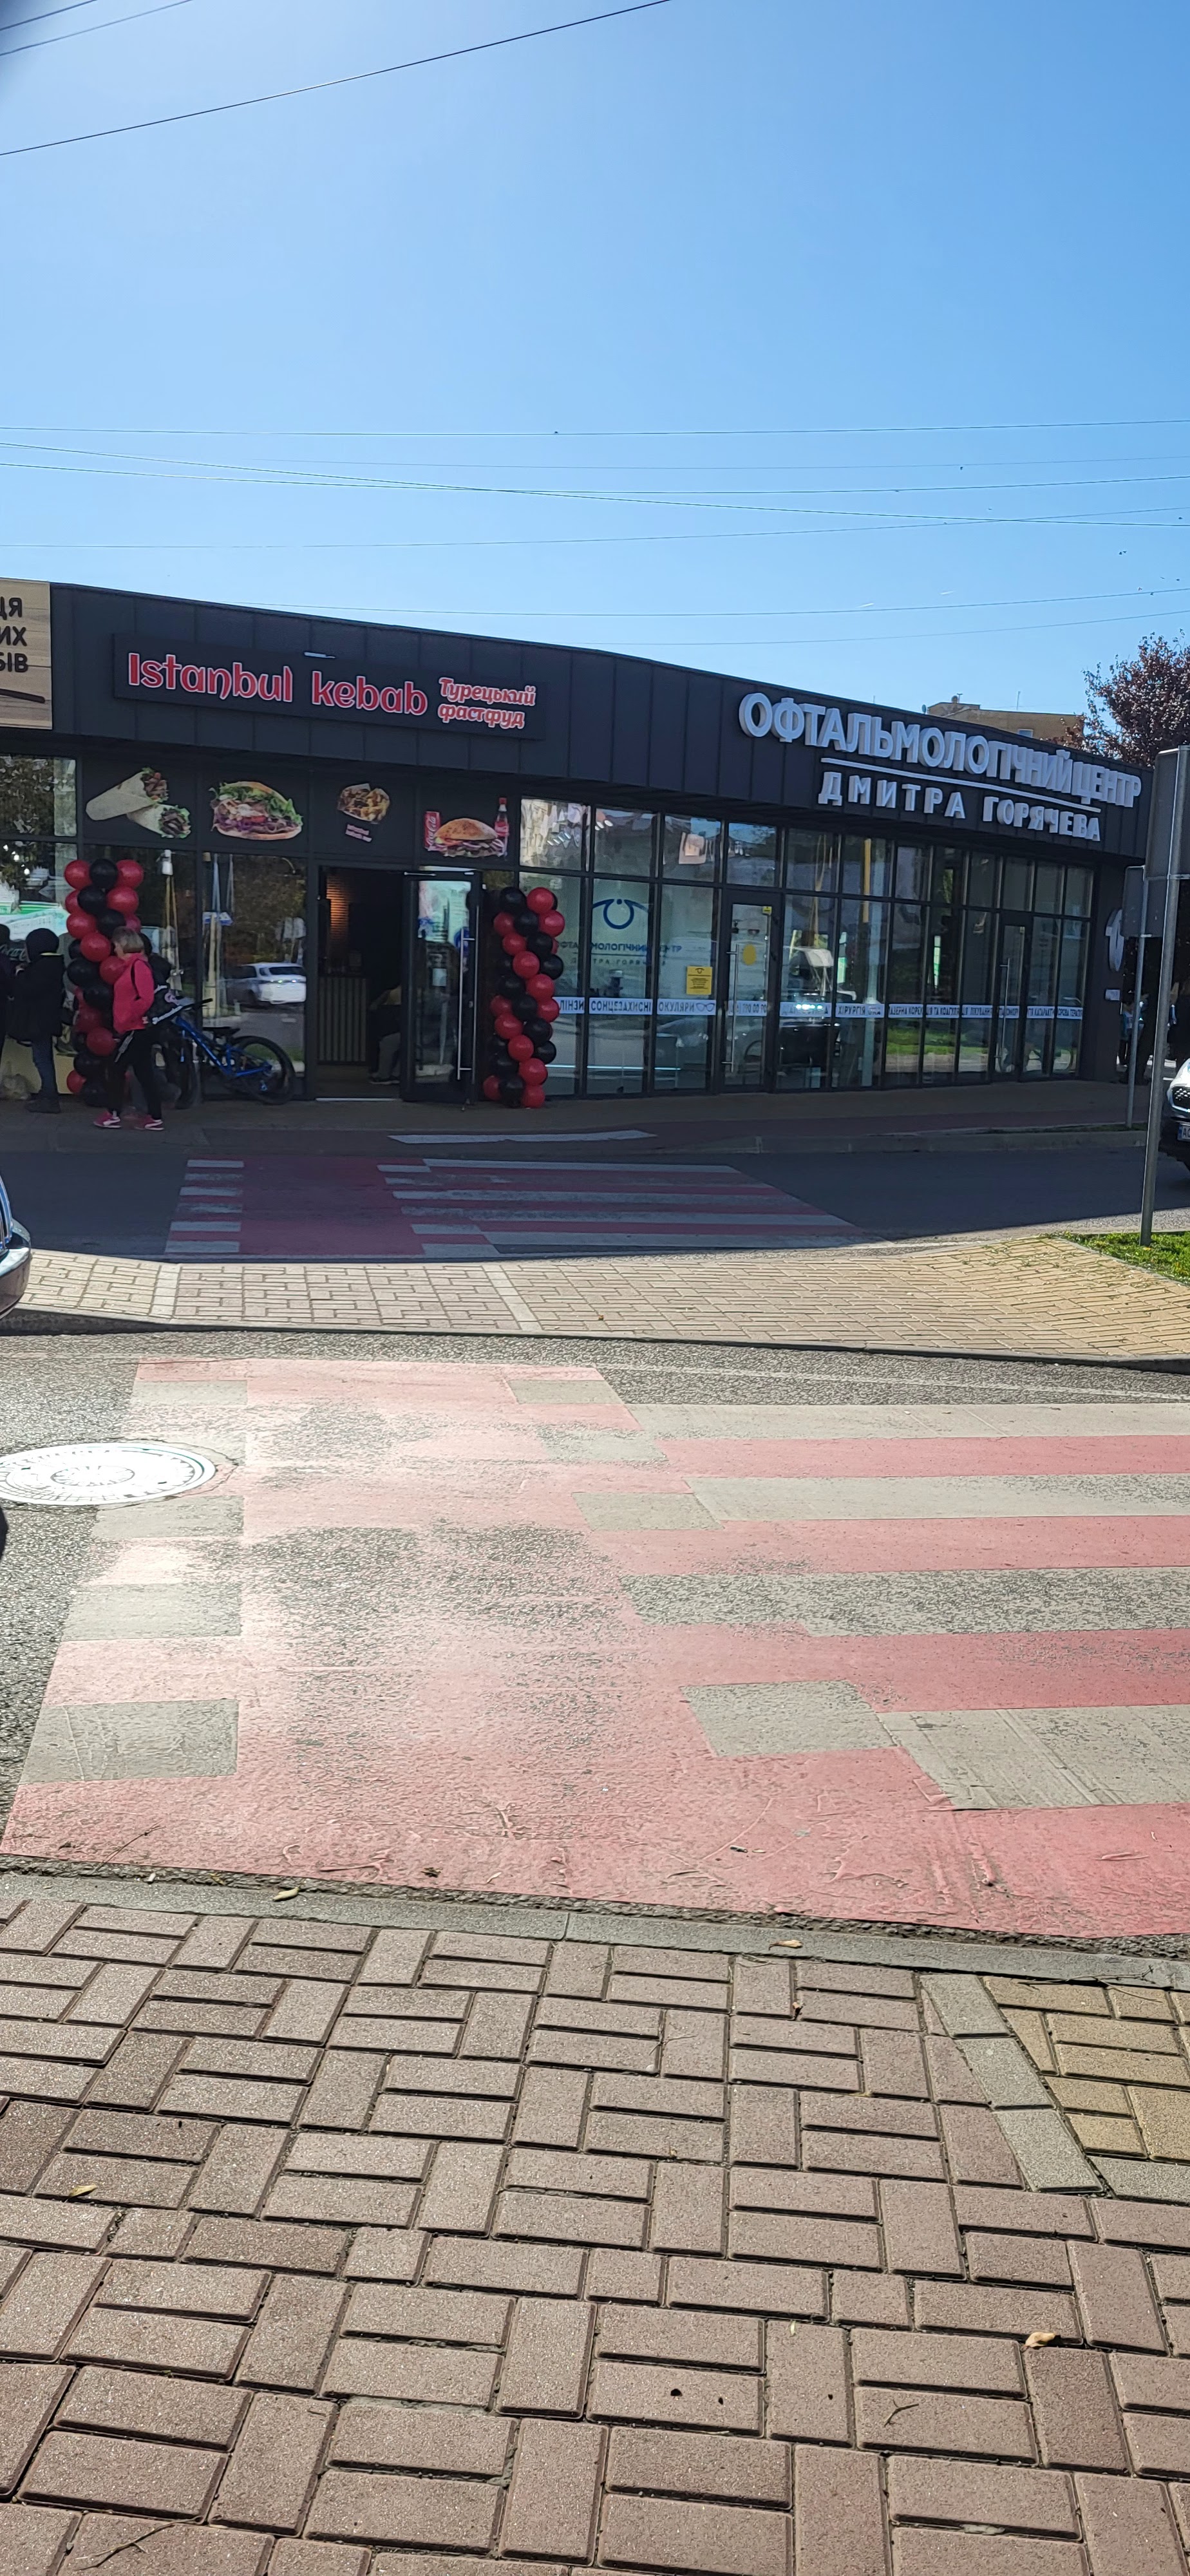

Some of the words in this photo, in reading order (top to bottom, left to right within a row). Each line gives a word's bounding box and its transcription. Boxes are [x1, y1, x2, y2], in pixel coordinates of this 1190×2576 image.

[129, 652, 293, 702] Istanbul
[312, 670, 428, 715] kebab
[439, 677, 537, 706] Турецький
[438, 703, 525, 729] фастфуд
[739, 692, 1073, 793] ОФТАЛЬМОЛОГІЧНИЙ
[1072, 761, 1142, 808] ЦЕНТР
[818, 772, 966, 819] ДМИТРА
[983, 796, 1100, 842] ГОРЯЧЕВА
[659, 1001, 695, 1012] ОКУЛЯРИ
[838, 1005, 865, 1015] ХІРУРГІЯ
